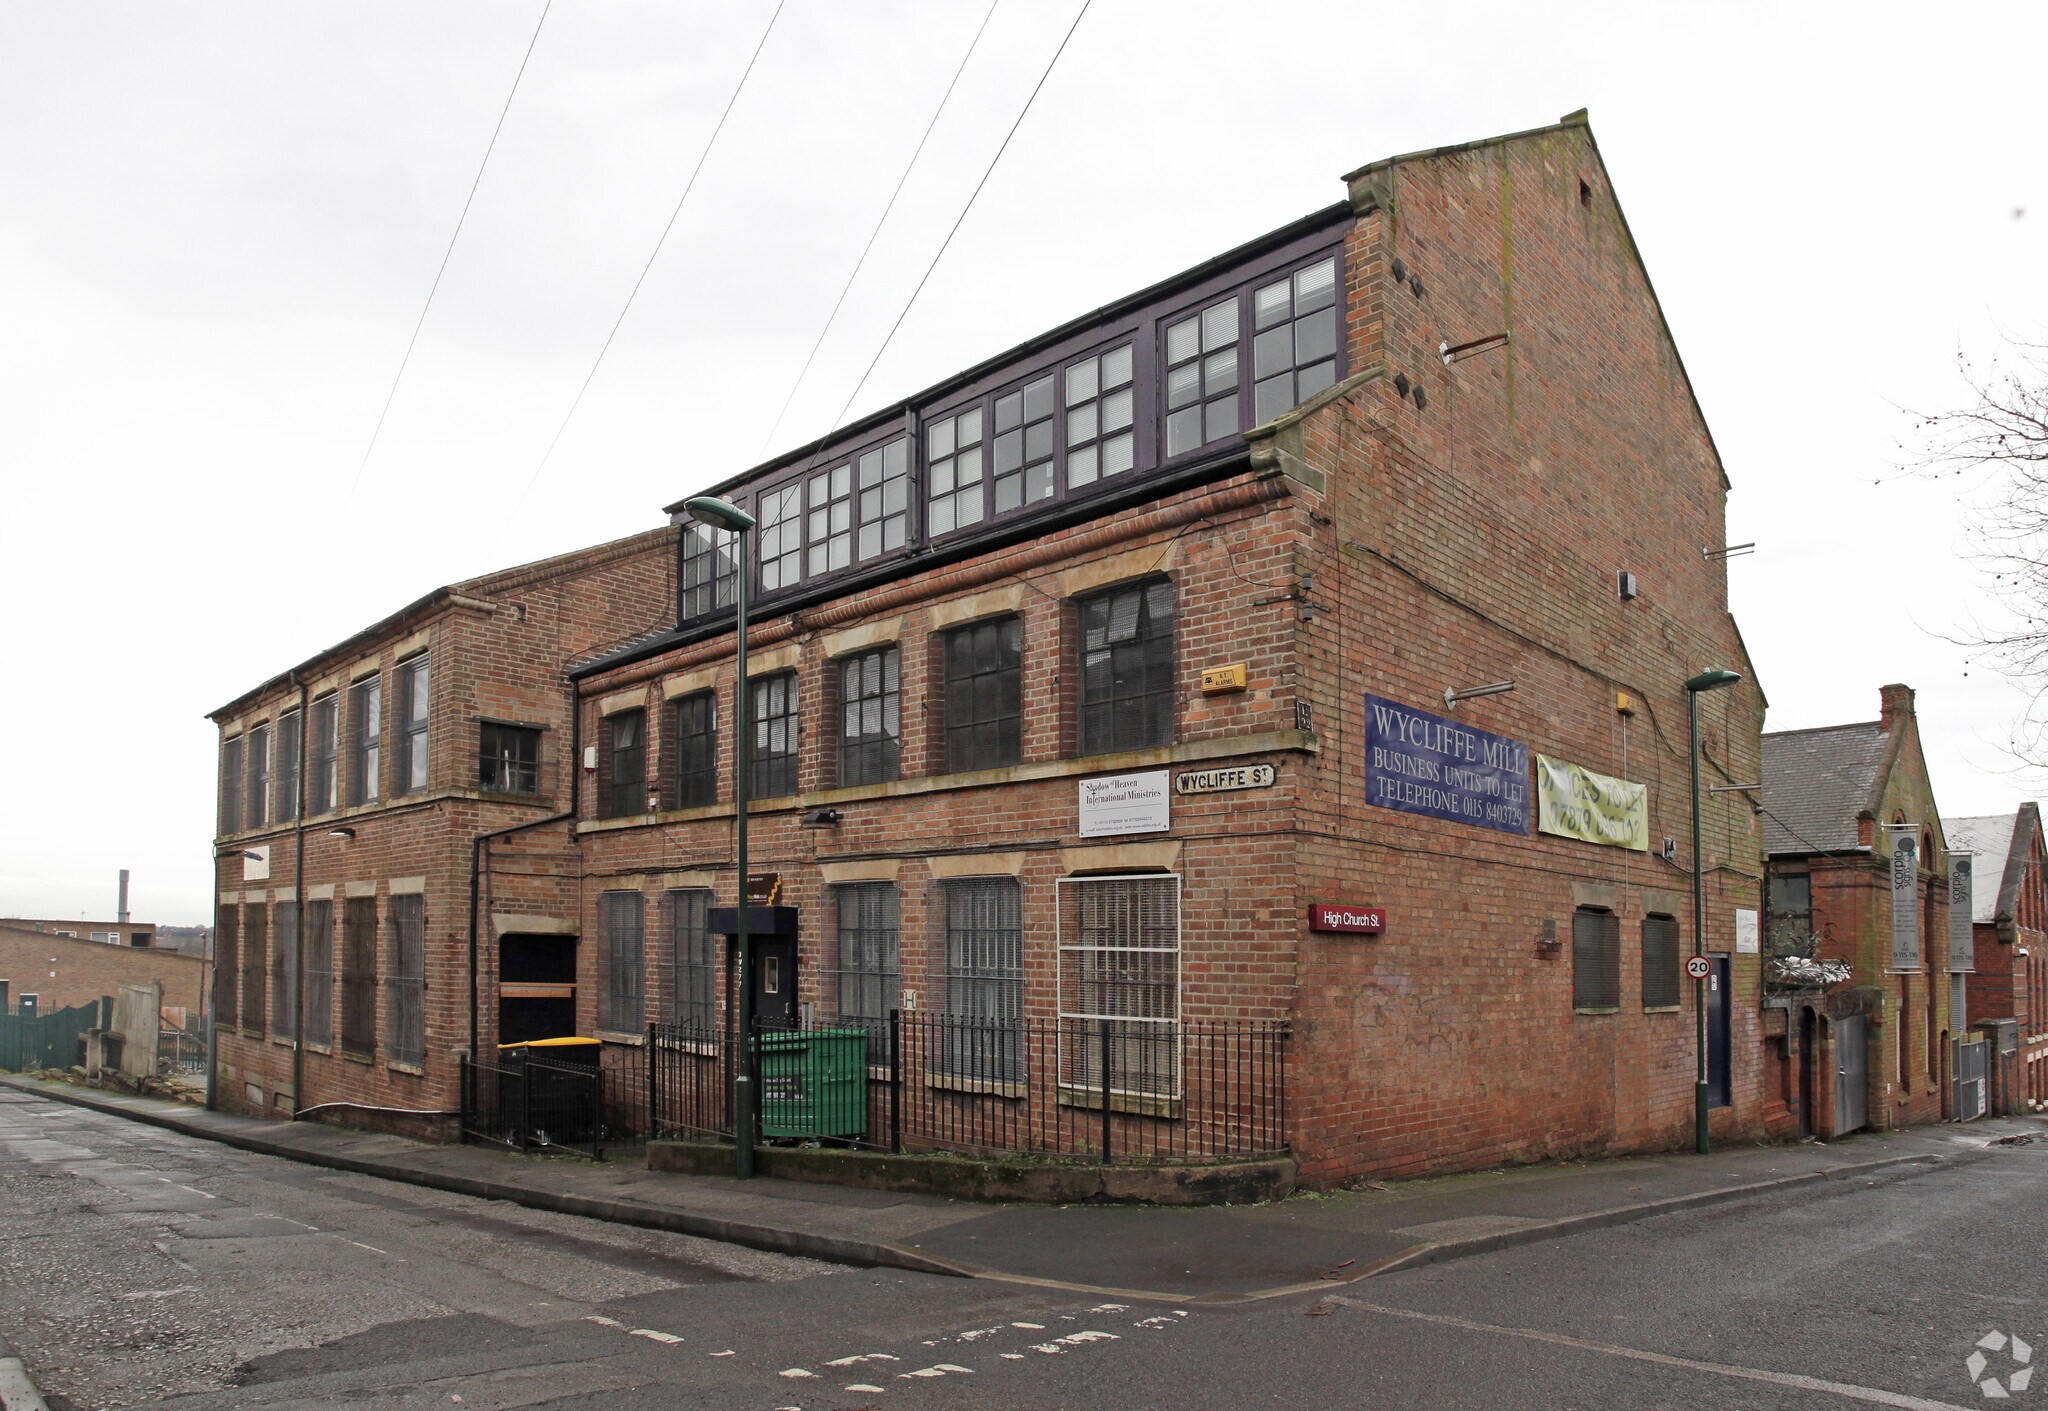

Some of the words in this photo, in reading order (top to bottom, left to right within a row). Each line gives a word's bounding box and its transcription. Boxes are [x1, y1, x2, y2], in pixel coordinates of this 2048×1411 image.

[1373, 704, 1477, 762] WYCLIFFE
[1482, 738, 1524, 775] MILL
[1181, 770, 1246, 790] WYCLIFFE
[1373, 746, 1440, 783] BUSINESS
[1444, 765, 1482, 793] UNITS
[1485, 776, 1500, 797] TO
[1504, 781, 1525, 803] LET
[1086, 782, 1110, 792] Shadow
[1114, 780, 1138, 789] Heaven
[1086, 791, 1127, 805] International
[1128, 788, 1161, 799] Ministries
[1376, 776, 1459, 813] TELEPHONE
[1463, 796, 1482, 818] 0115
[1486, 802, 1523, 827] 8403729
[1891, 850, 1906, 890] scorpio
[1904, 867, 1913, 888] signs
[1950, 871, 1963, 904] scorpio
[1960, 885, 1969, 903] signs
[1324, 911, 1342, 928] High
[1343, 912, 1370, 926] Church
[1689, 962, 1708, 972] 20
